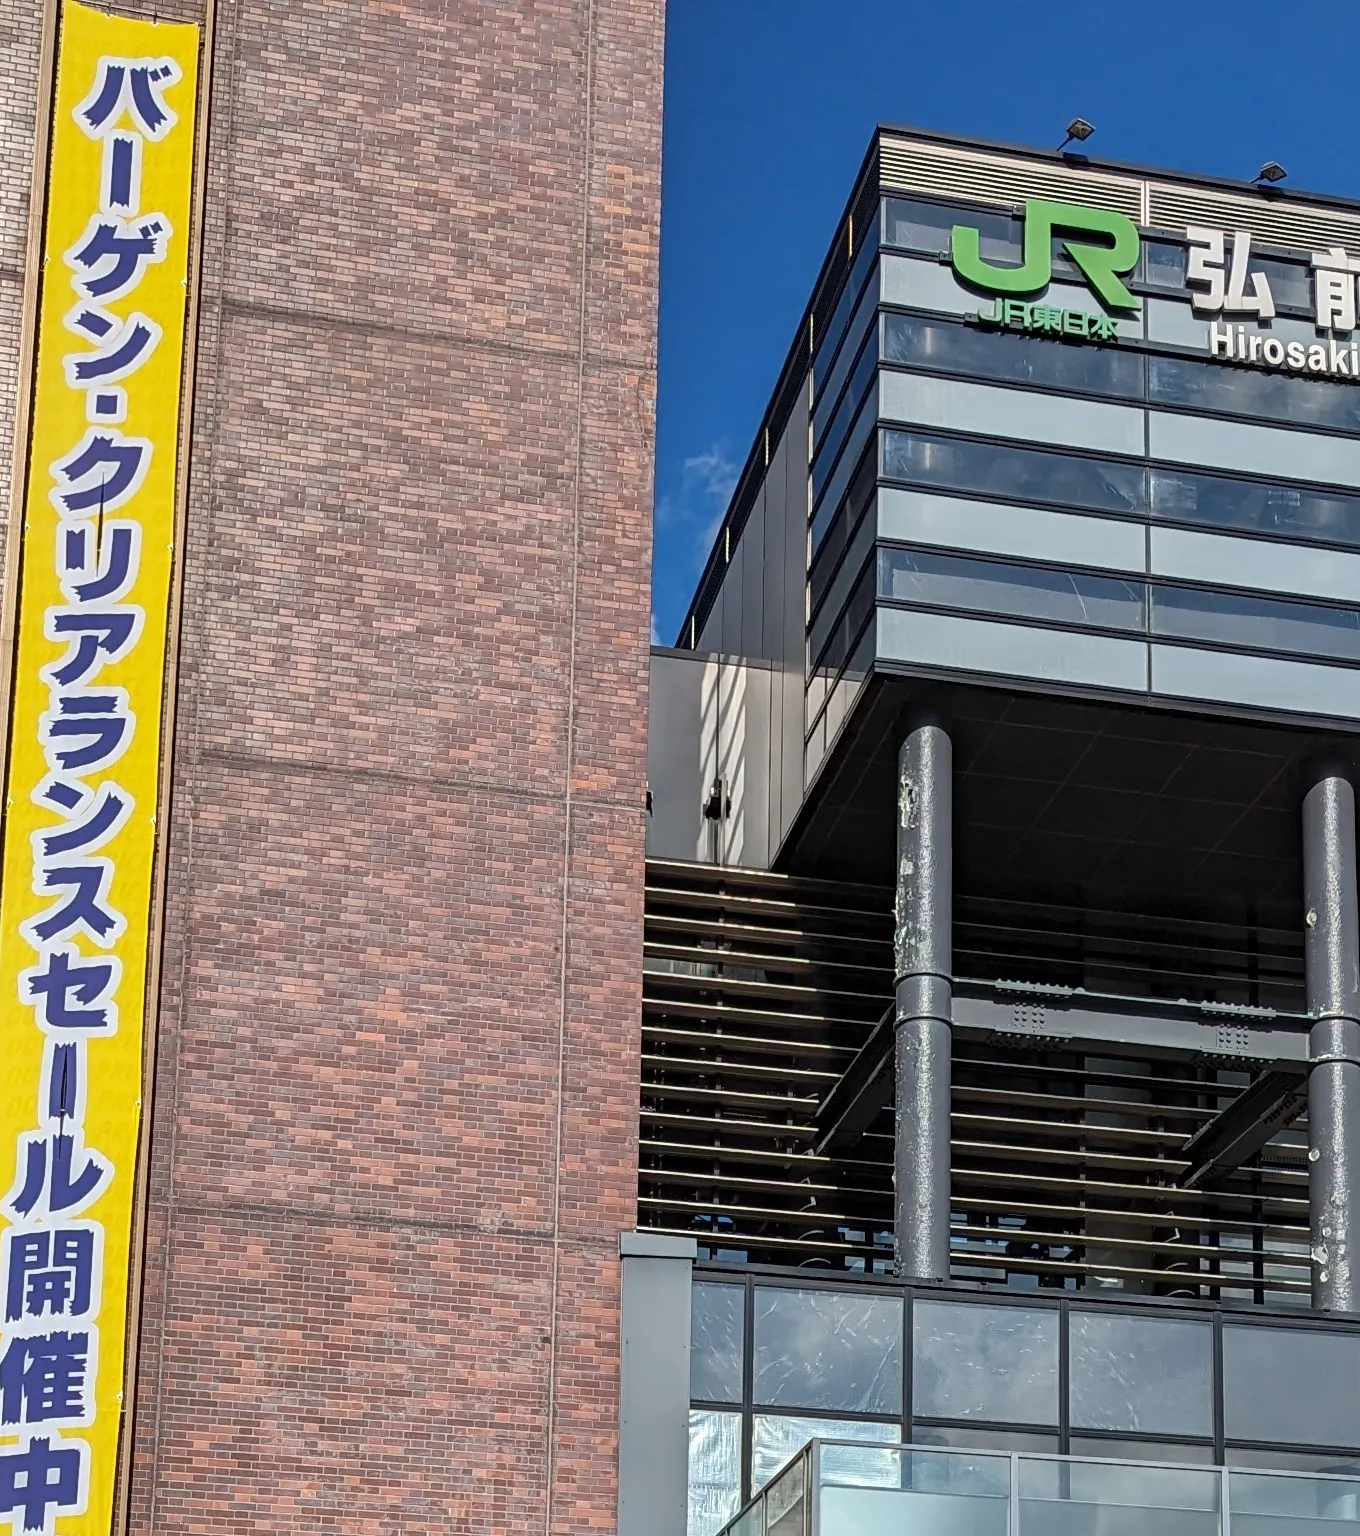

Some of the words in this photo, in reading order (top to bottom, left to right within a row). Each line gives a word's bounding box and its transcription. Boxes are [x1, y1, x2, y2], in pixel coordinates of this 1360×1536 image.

[952, 198, 1143, 311] JR
[979, 296, 1120, 341] JR東日本
[1210, 321, 1360, 377] Hirosaki
